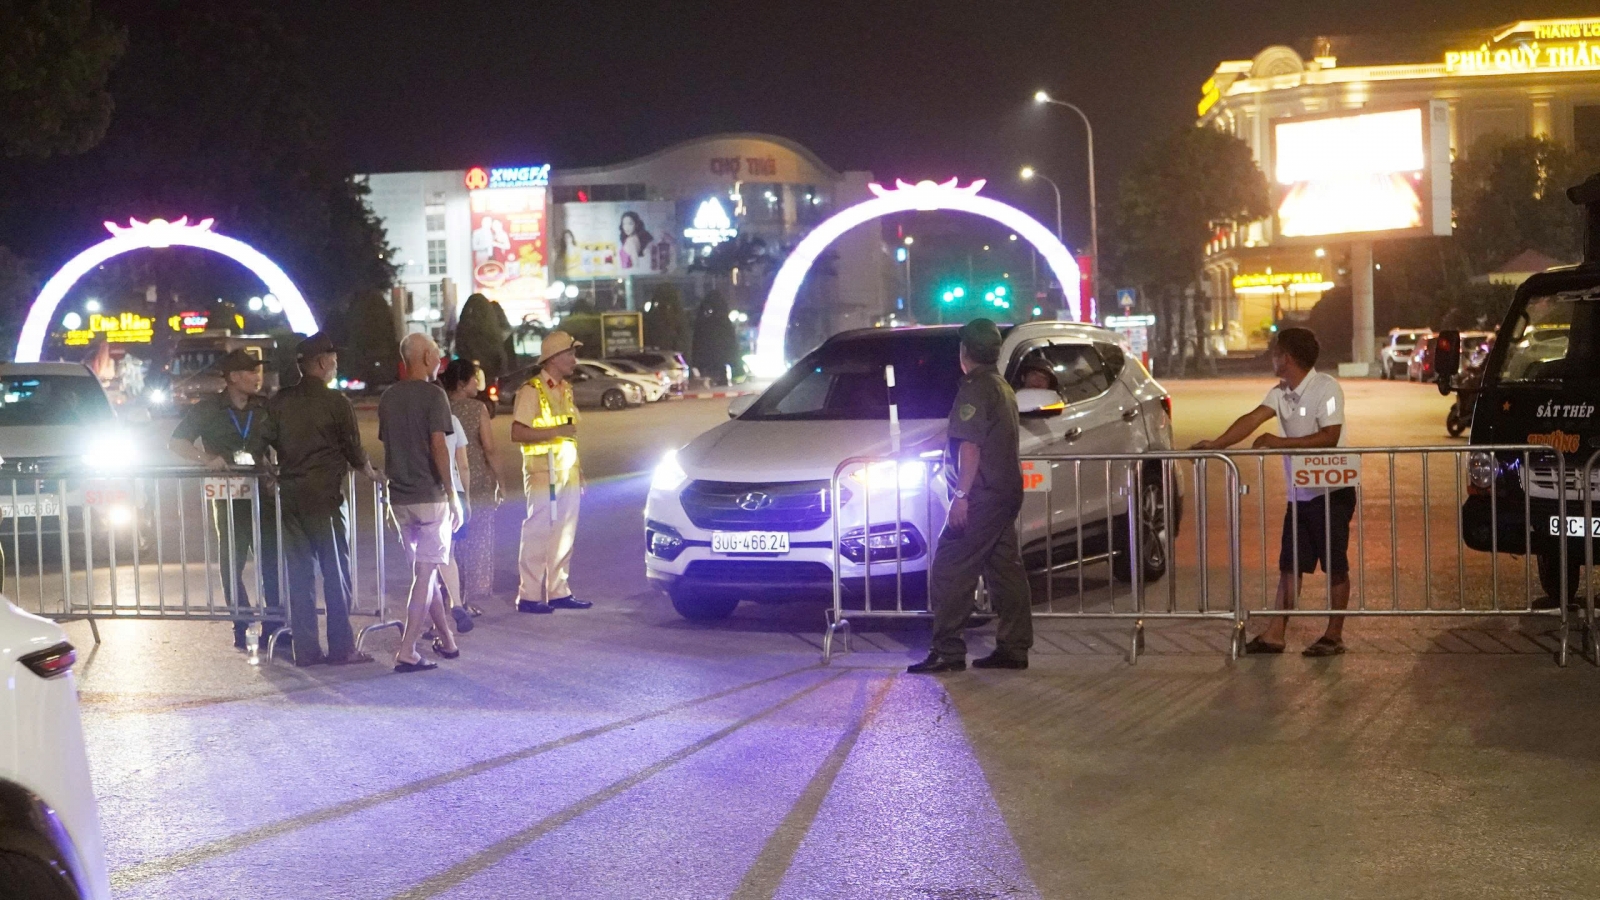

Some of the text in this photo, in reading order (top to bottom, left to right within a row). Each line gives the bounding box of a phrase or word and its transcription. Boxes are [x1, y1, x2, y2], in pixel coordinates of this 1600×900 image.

[1445, 43, 1491, 72] PHÚ
[1494, 41, 1541, 71] QUÝ
[1536, 399, 1595, 418] SẮT THÉP
[1304, 456, 1348, 466] POLICE
[1294, 468, 1358, 485] STOP
[714, 534, 786, 550] 30G-466.24
